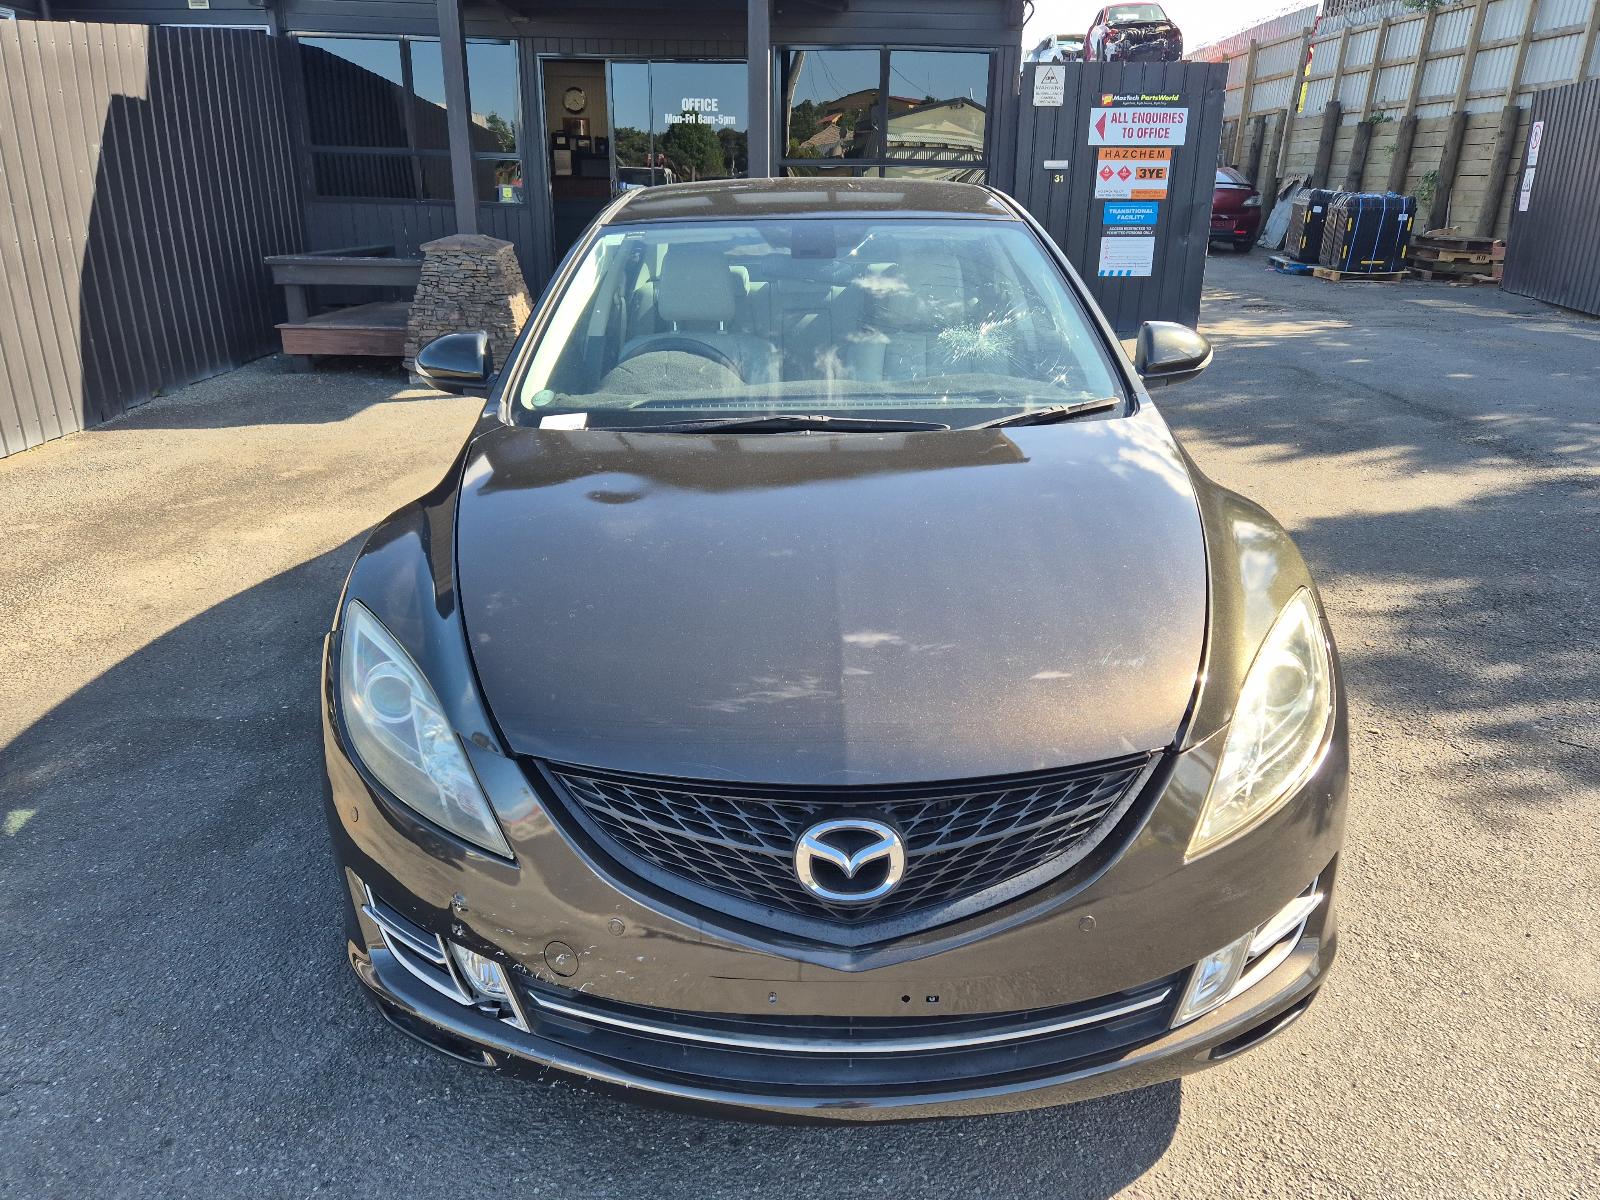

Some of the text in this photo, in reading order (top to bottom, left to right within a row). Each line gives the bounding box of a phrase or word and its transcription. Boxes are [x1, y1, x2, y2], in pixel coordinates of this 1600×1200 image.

[682, 98, 718, 111] OFFICE
[664, 113, 736, 126] Mon-Fri 8am-5pm
[1111, 112, 1184, 125] ALL ENQUIRIES
[1122, 127, 1171, 139] TO OFFICE
[1105, 149, 1165, 159] HAZCHEM
[1054, 174, 1064, 183] 31
[1139, 168, 1164, 179] 3YE
